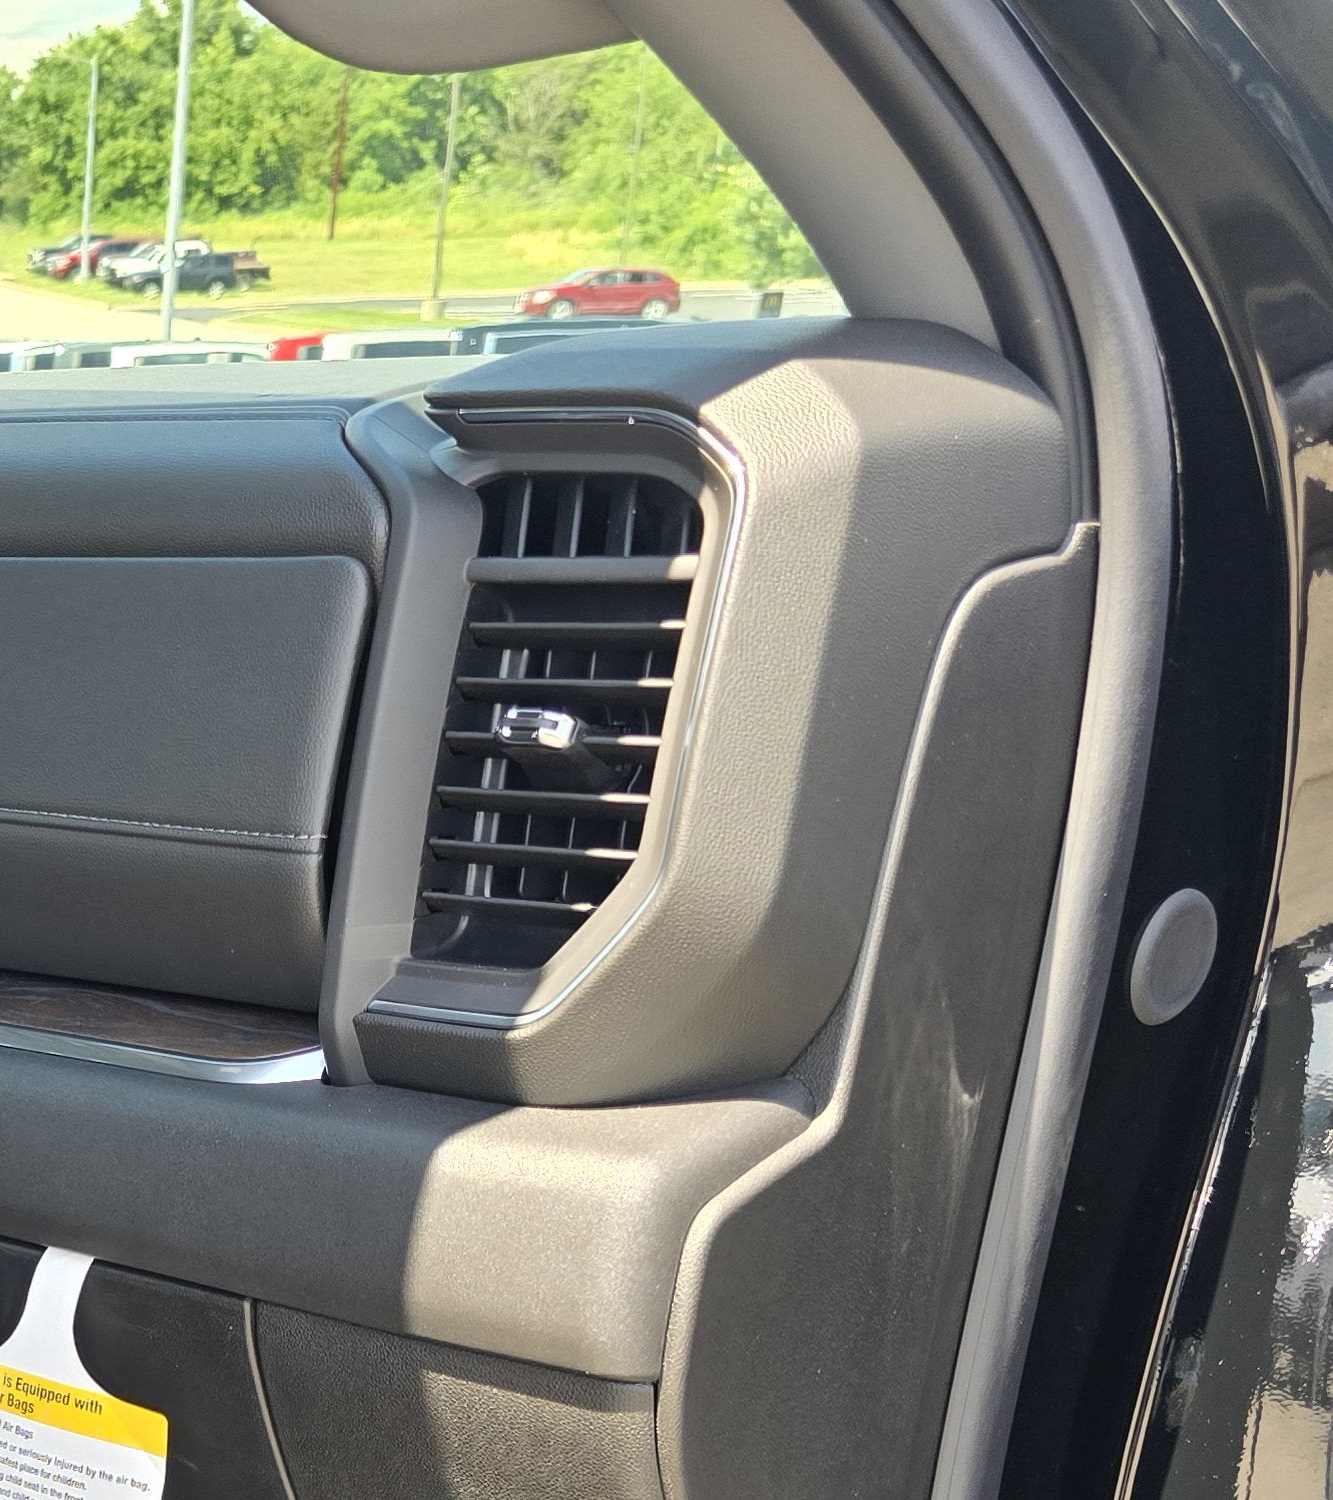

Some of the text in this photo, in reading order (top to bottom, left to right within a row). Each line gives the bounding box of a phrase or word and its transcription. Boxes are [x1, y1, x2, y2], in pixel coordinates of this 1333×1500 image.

[3, 1373, 12, 1388] is
[16, 1377, 70, 1406] Equipped
[74, 1398, 102, 1415] with
[8, 1393, 34, 1414] Bags
[2, 1421, 14, 1432] Air
[14, 1426, 34, 1440] Bags
[18, 1446, 52, 1466] seriously
[86, 1466, 96, 1479] by
[99, 1470, 114, 1482] the
[116, 1476, 129, 1485] air
[130, 1478, 150, 1492] bag.
[19, 1464, 39, 1476] place
[40, 1468, 52, 1480] for
[53, 1474, 87, 1490] children.
[5, 1474, 22, 1487] child
[24, 1480, 40, 1492] seat
[41, 1484, 48, 1494] in
[50, 1488, 62, 1500] the
